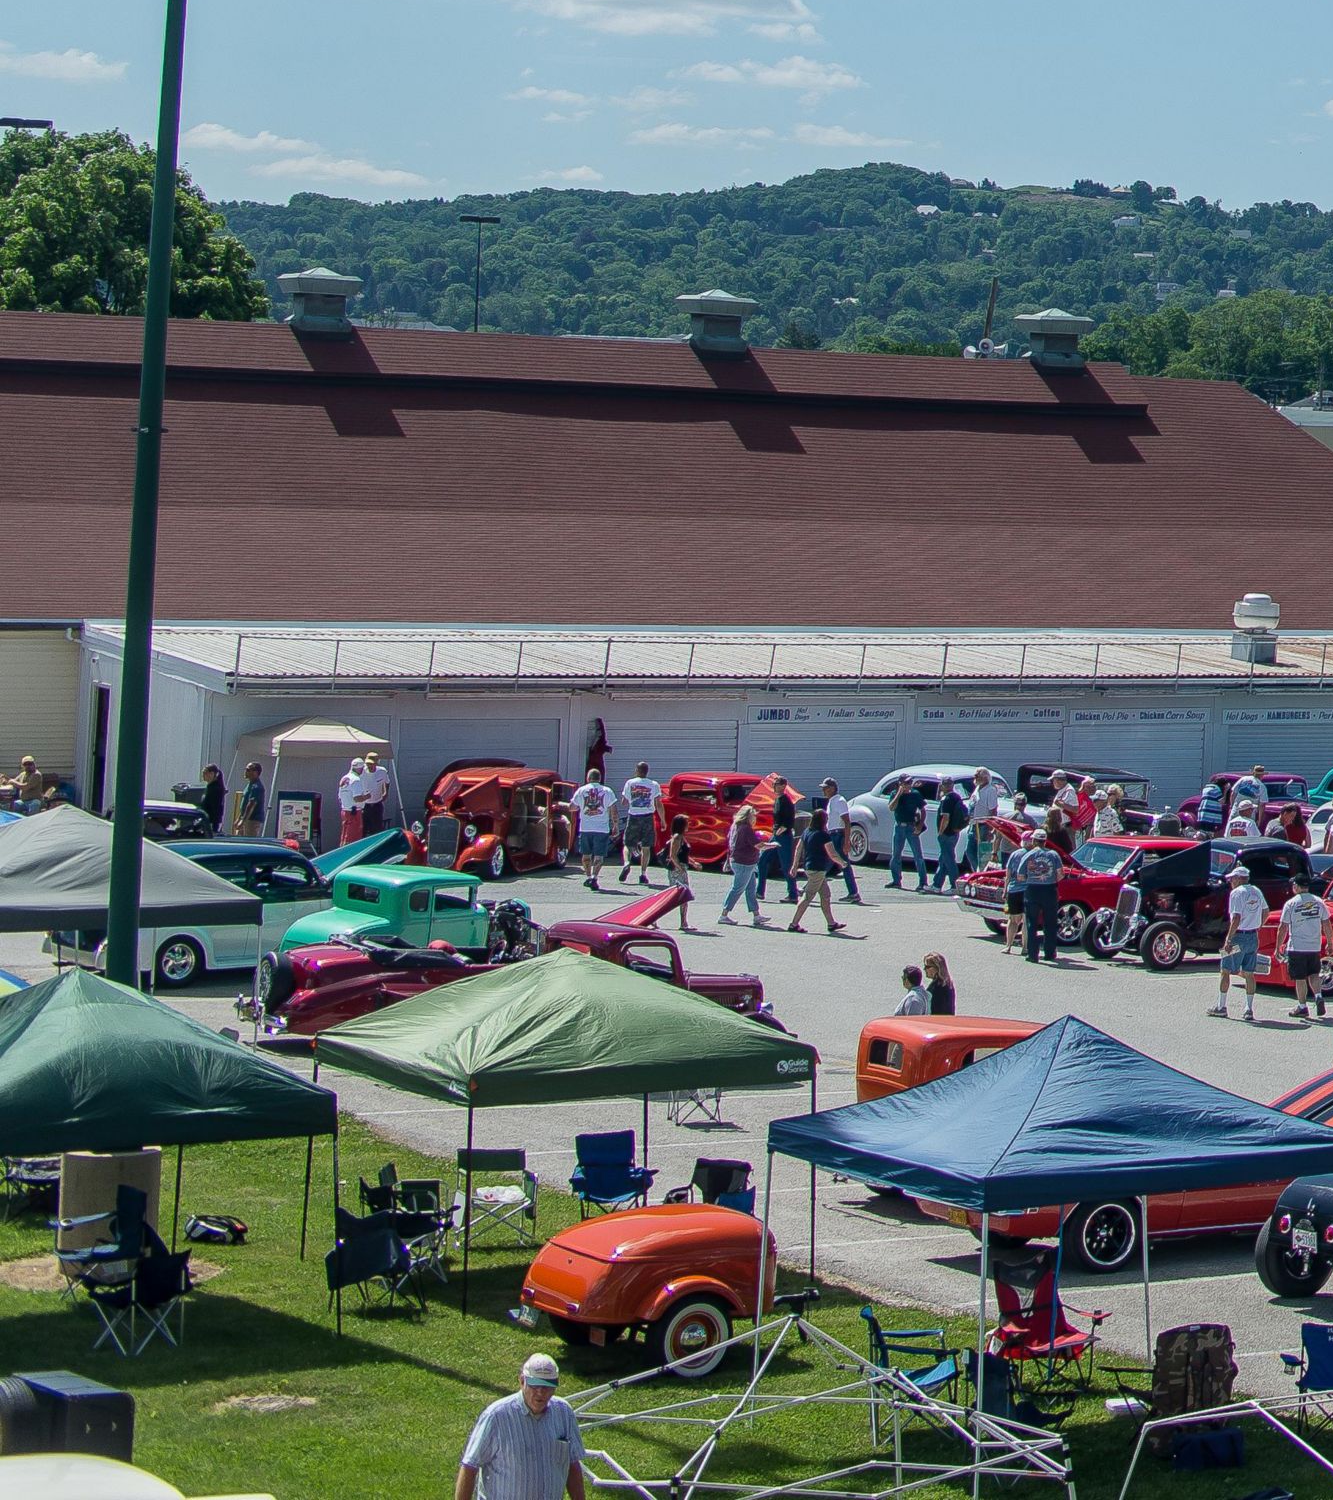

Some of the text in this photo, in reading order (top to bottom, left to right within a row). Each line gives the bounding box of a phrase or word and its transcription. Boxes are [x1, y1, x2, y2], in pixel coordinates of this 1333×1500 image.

[757, 708, 790, 720] JUMBO
[827, 708, 895, 719] Italian Sausage
[923, 708, 1061, 718] Soda Bottled Water Coffee
[1075, 710, 1205, 721] Chicken Pot Pie Chicken Corn Soup
[1226, 712, 1239, 721] Hot
[1240, 712, 1258, 721] Dogs
[1267, 711, 1310, 720] HAMBURGERS
